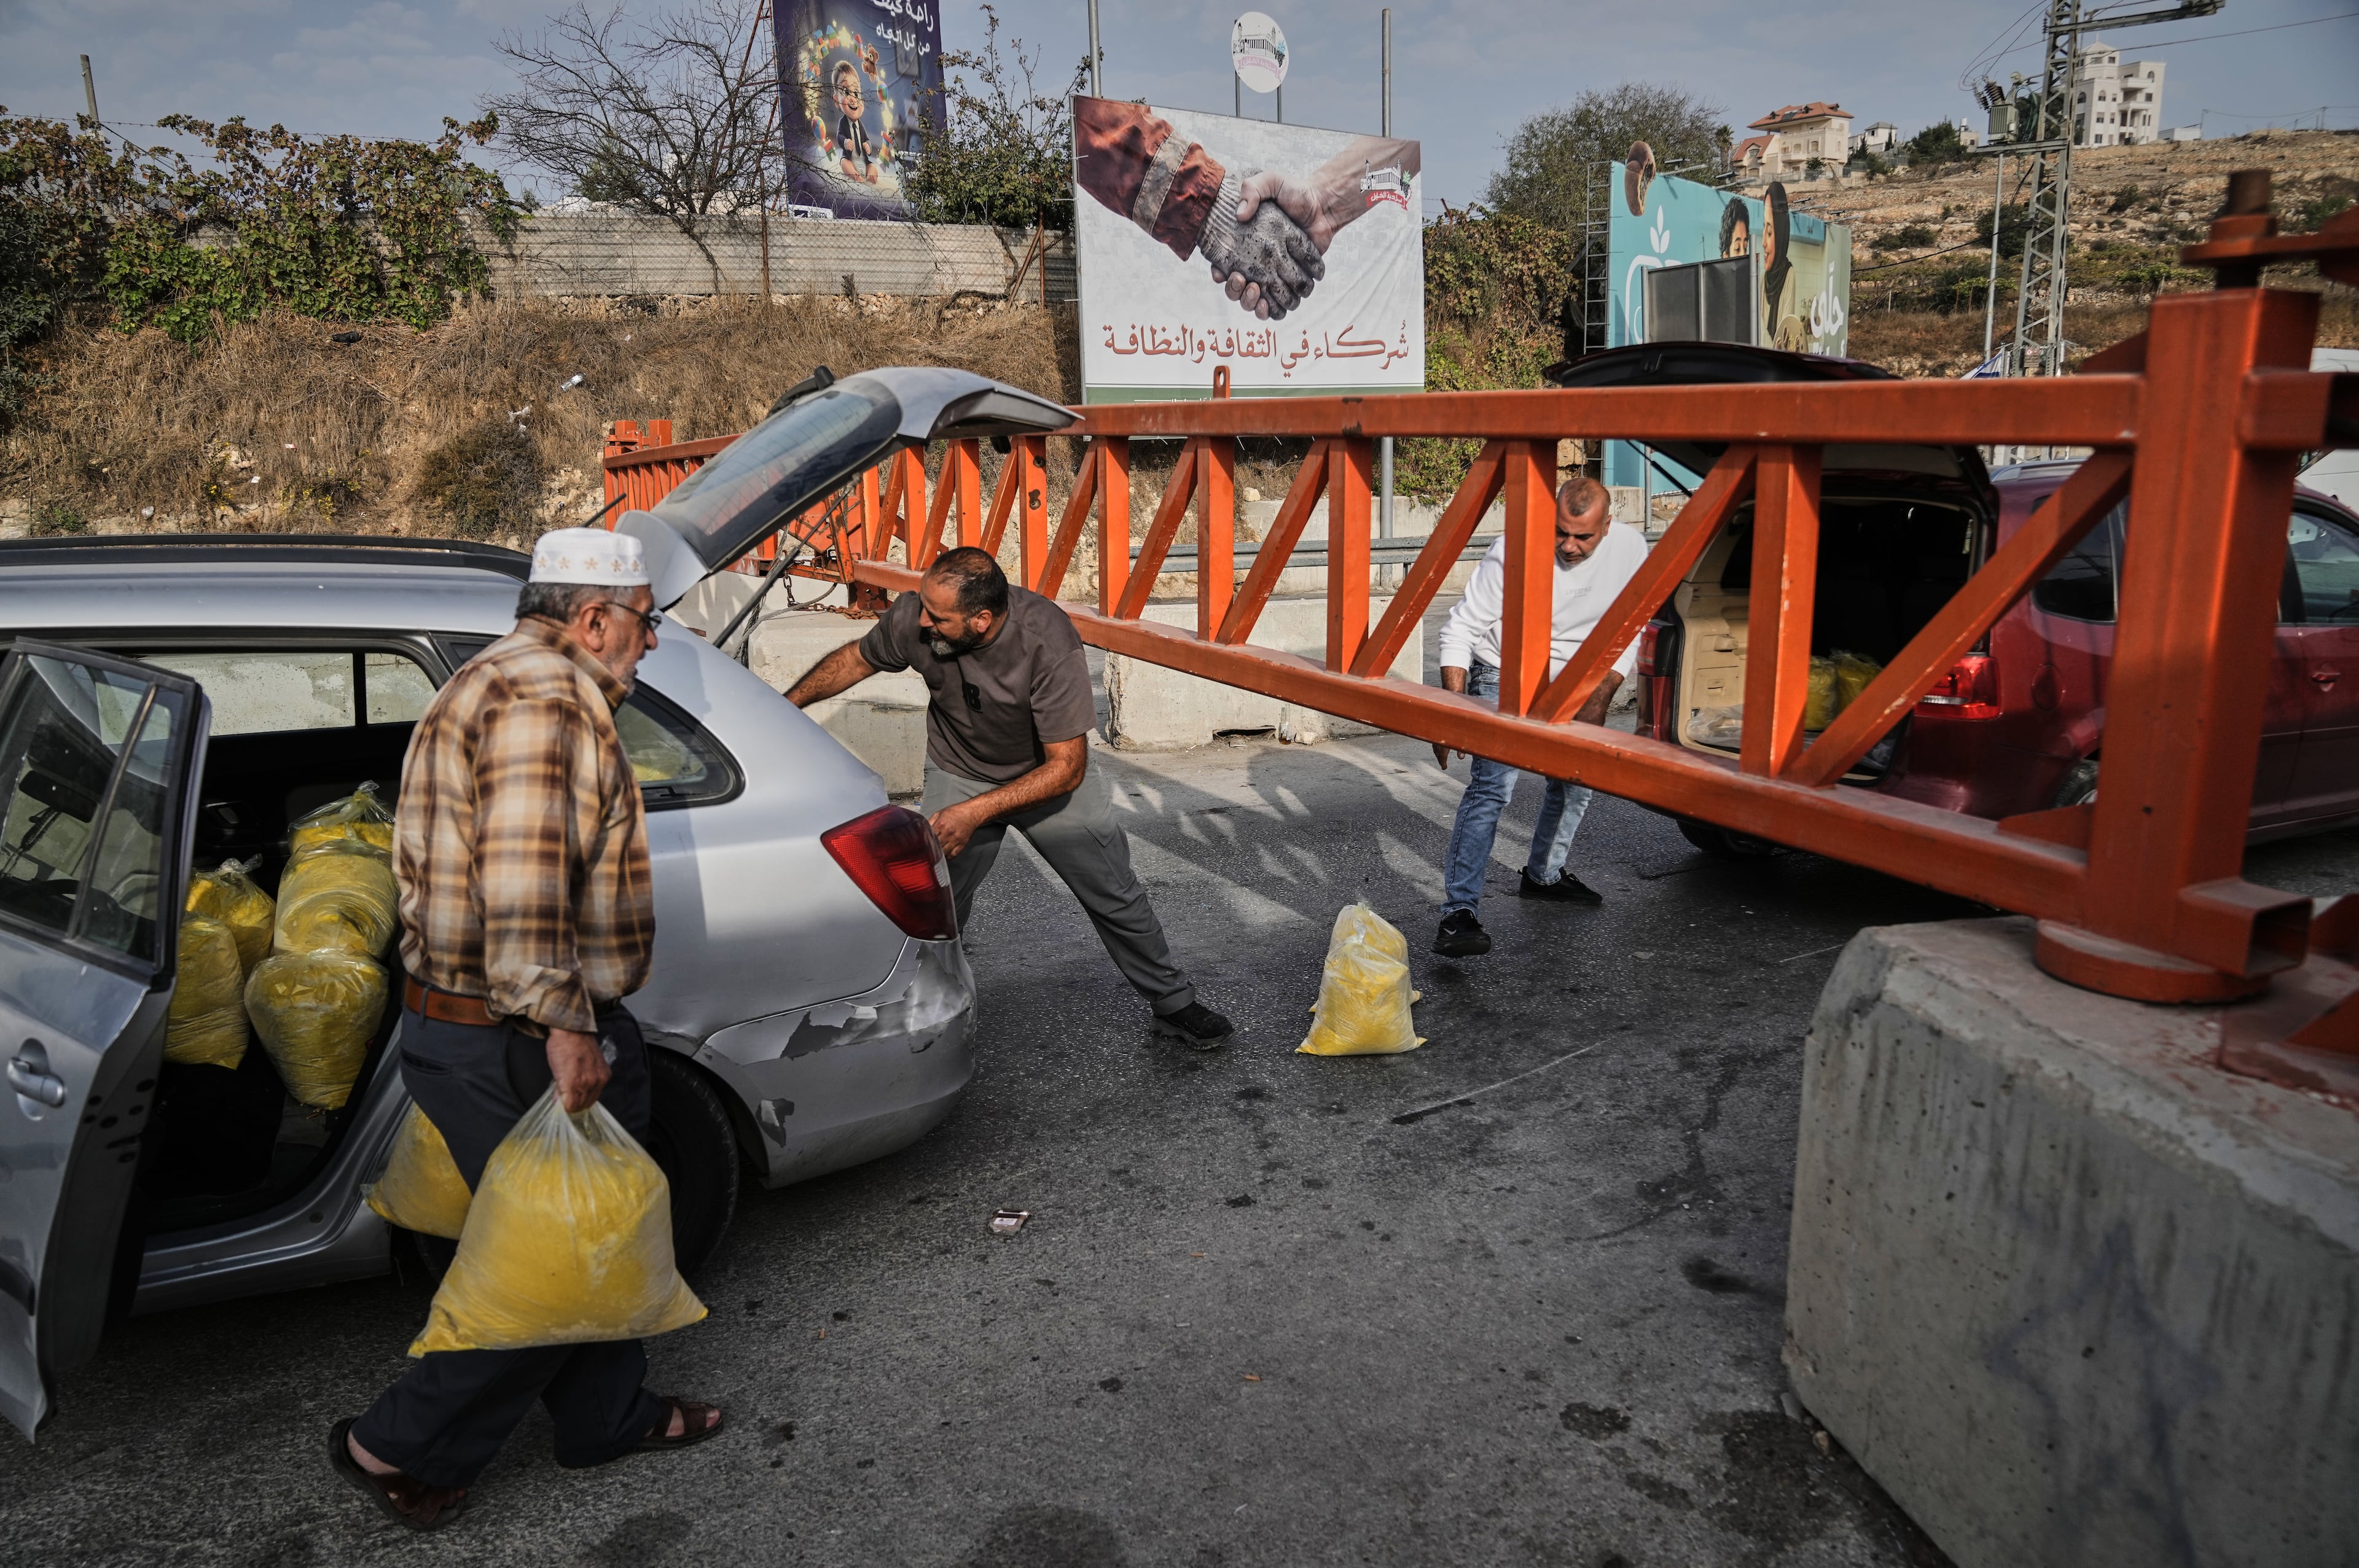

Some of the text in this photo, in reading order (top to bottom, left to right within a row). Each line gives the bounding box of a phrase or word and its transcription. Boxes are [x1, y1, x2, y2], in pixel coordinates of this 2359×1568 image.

[876, 22, 931, 56] من كل اتجاه
[1371, 191, 1387, 201] الخليل
[1102, 323, 1205, 364] والنظافة
[1207, 326, 1277, 357] الثقافة
[1280, 329, 1310, 378] في
